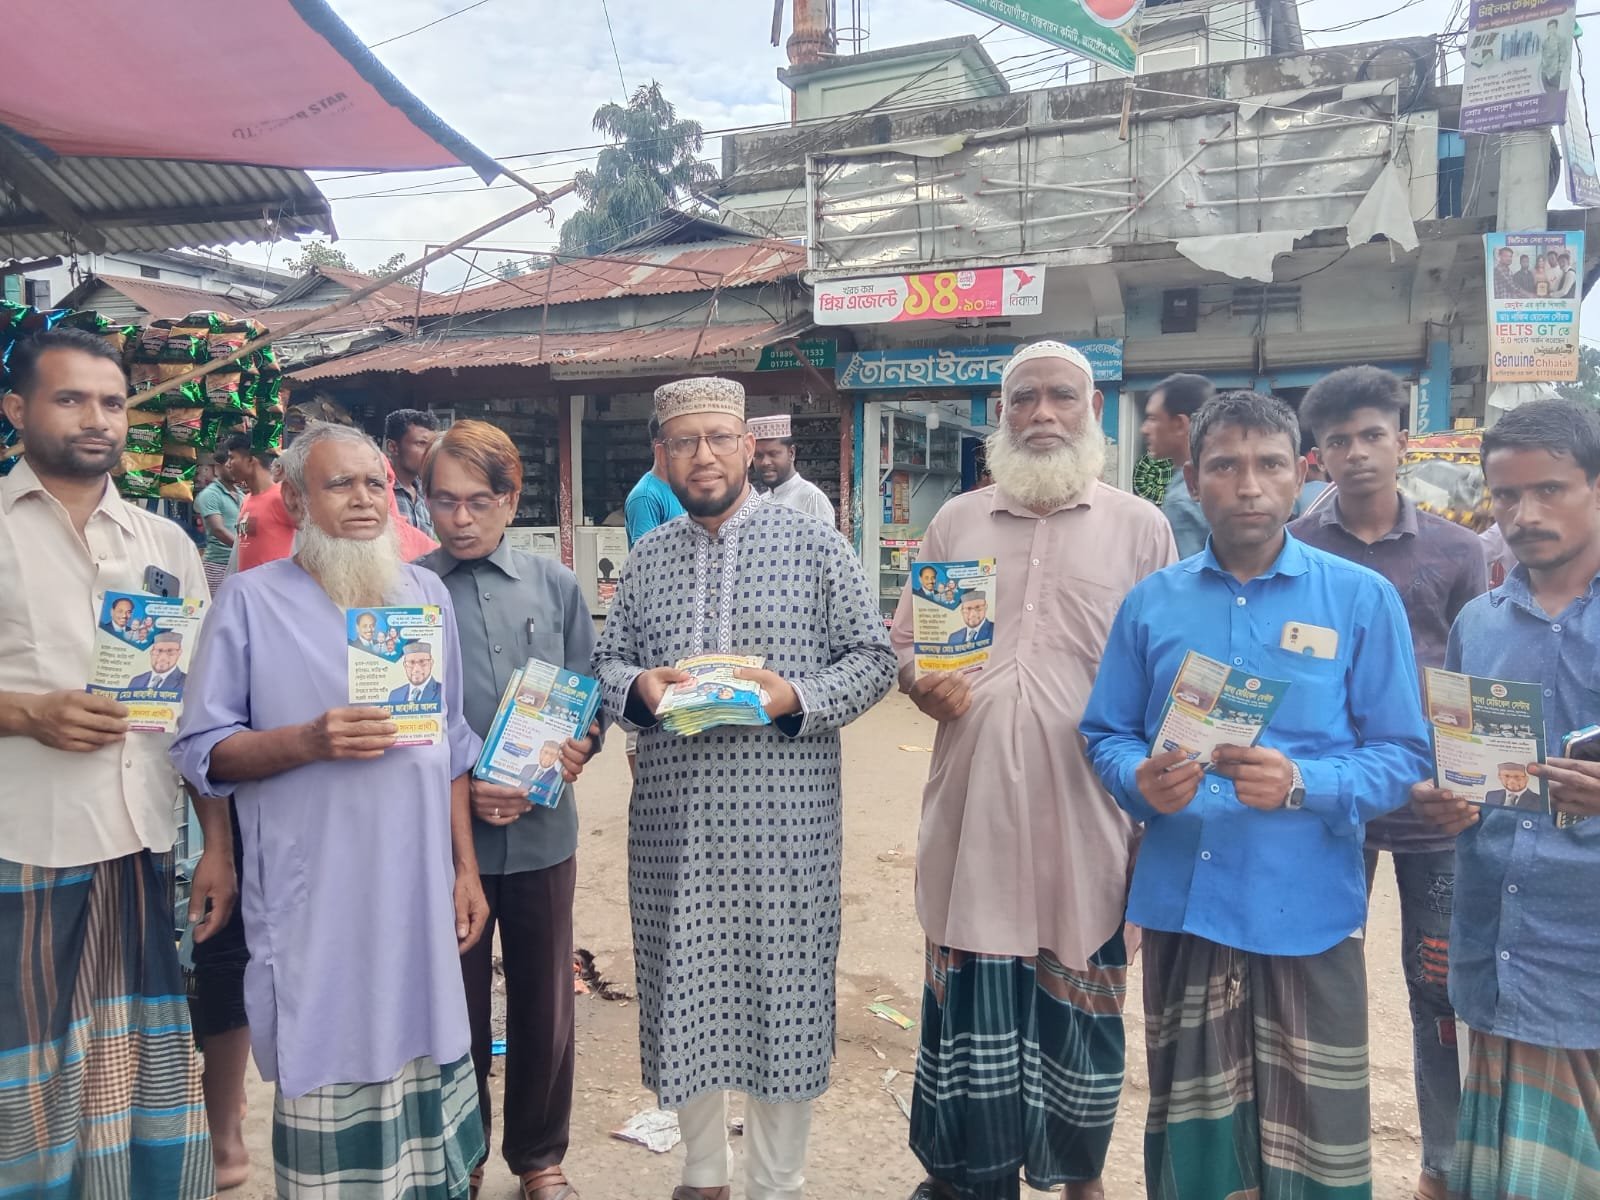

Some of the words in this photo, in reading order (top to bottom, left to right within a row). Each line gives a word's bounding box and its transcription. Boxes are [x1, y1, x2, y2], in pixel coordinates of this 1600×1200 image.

[860, 285, 874, 294] কম
[819, 293, 844, 312] প্রিয়
[846, 289, 897, 310] এজেন্টে
[1009, 293, 1038, 307] বিকাশ
[1495, 324, 1533, 336] IELTS
[1537, 324, 1557, 336] GT
[1494, 351, 1534, 367] Genuine
[1535, 359, 1574, 368] Chhatak
